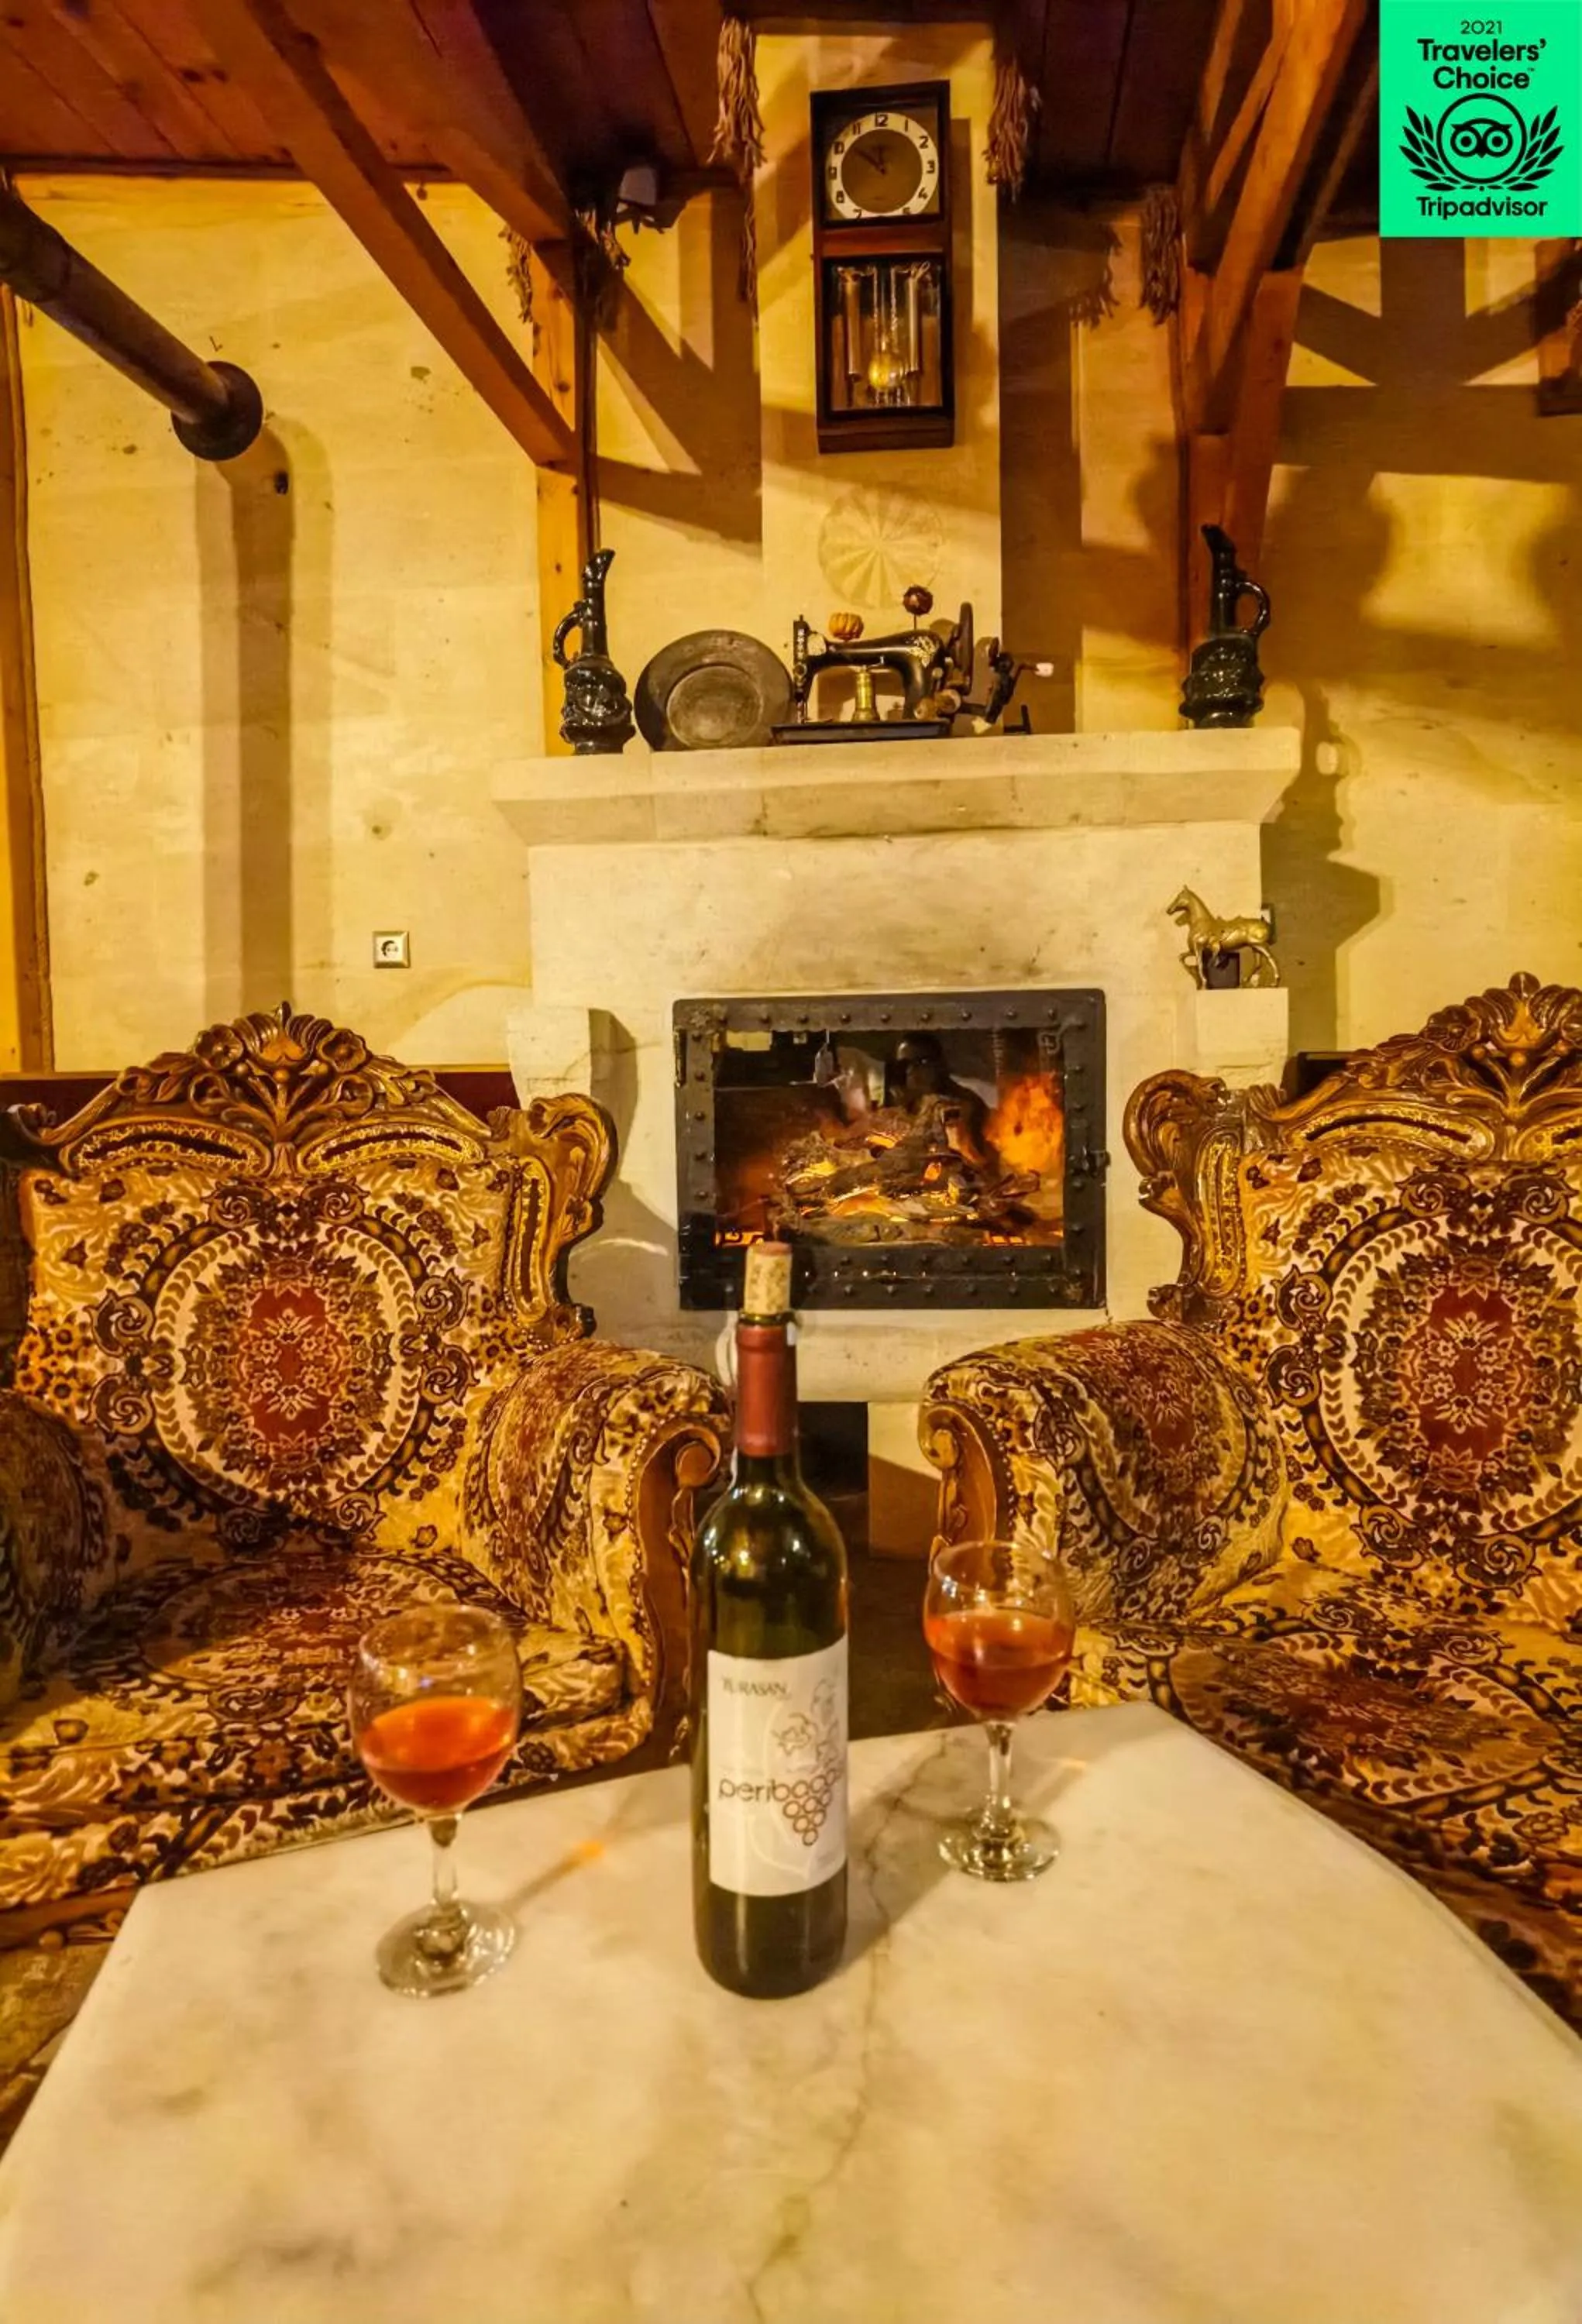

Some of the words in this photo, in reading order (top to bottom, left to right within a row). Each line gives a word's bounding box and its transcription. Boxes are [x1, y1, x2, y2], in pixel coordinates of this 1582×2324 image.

[875, 114, 889, 127] 12
[853, 122, 862, 135] 11
[919, 136, 929, 149] 2
[927, 160, 935, 174] 3
[918, 187, 928, 200] 4
